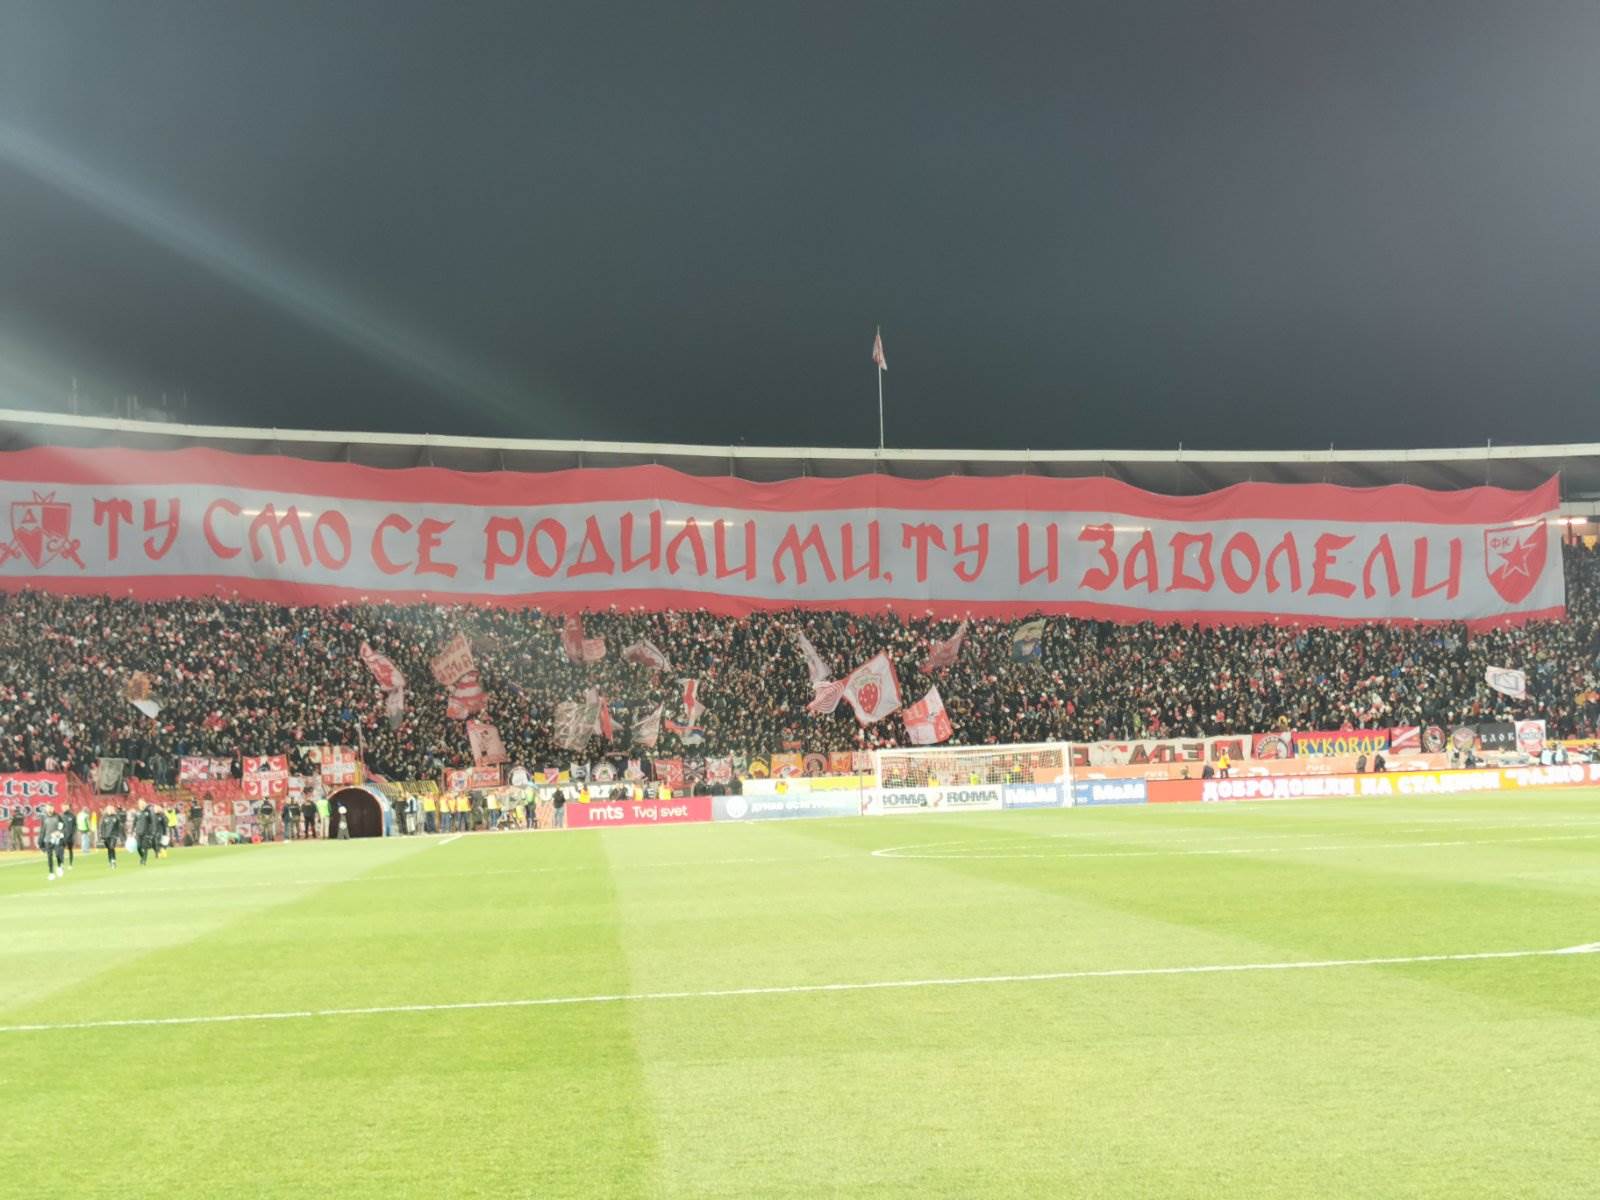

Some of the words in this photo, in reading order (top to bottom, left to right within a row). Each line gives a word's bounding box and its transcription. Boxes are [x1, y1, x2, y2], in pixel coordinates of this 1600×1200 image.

[92, 497, 180, 560] ТУ
[202, 498, 352, 570] СМО
[371, 513, 458, 578] СЕ
[483, 510, 756, 581] РОДИЛИ
[902, 522, 990, 583] ТУ
[1016, 522, 1059, 586] И
[1077, 521, 1461, 600] ЗАВОЛЕЛИ
[1297, 735, 1386, 758] ВУКОВАР
[946, 789, 1000, 803] ROMA
[589, 805, 624, 820] mts
[632, 806, 657, 820] Tvoj
[661, 806, 687, 817] svet
